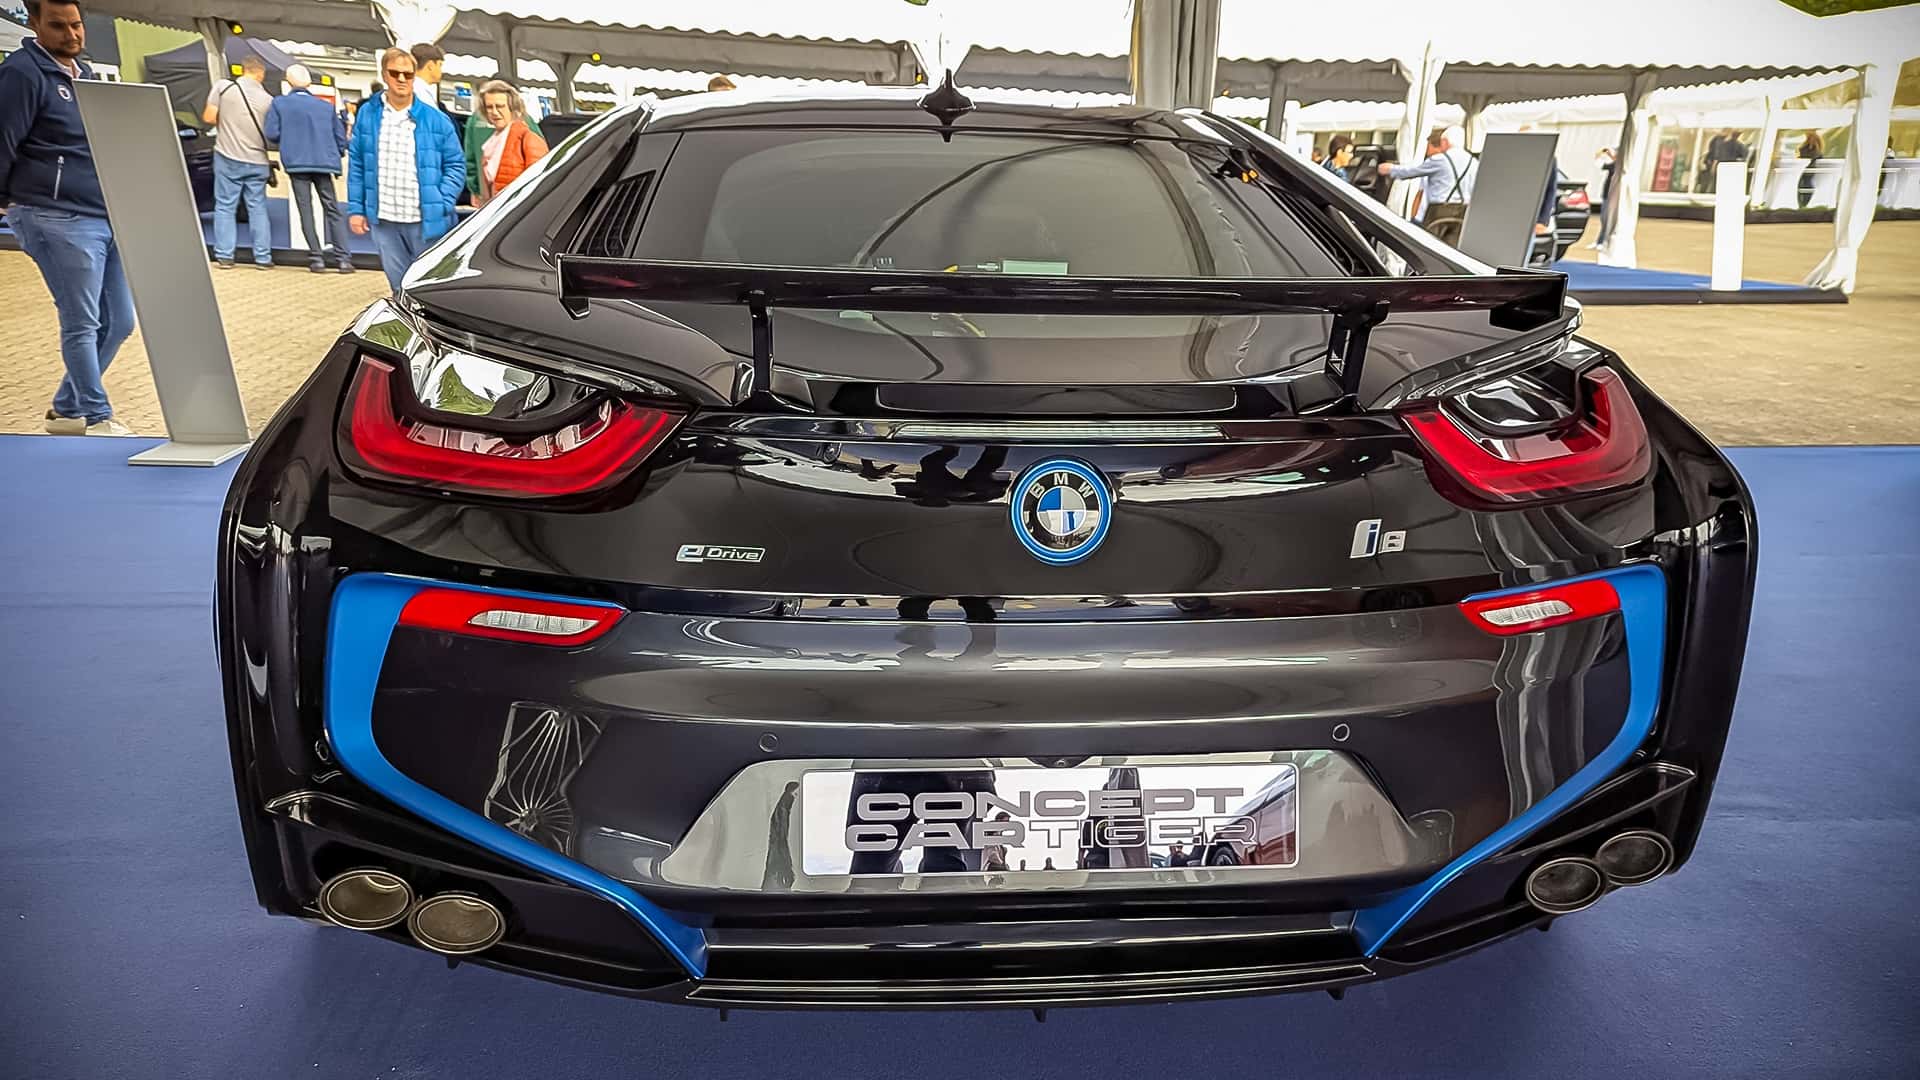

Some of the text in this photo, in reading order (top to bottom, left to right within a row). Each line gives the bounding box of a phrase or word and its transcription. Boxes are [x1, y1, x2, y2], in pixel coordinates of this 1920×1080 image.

[1029, 472, 1094, 499] BMW
[857, 787, 1244, 821] CONCEPT
[844, 815, 1258, 852] CARTIGER
